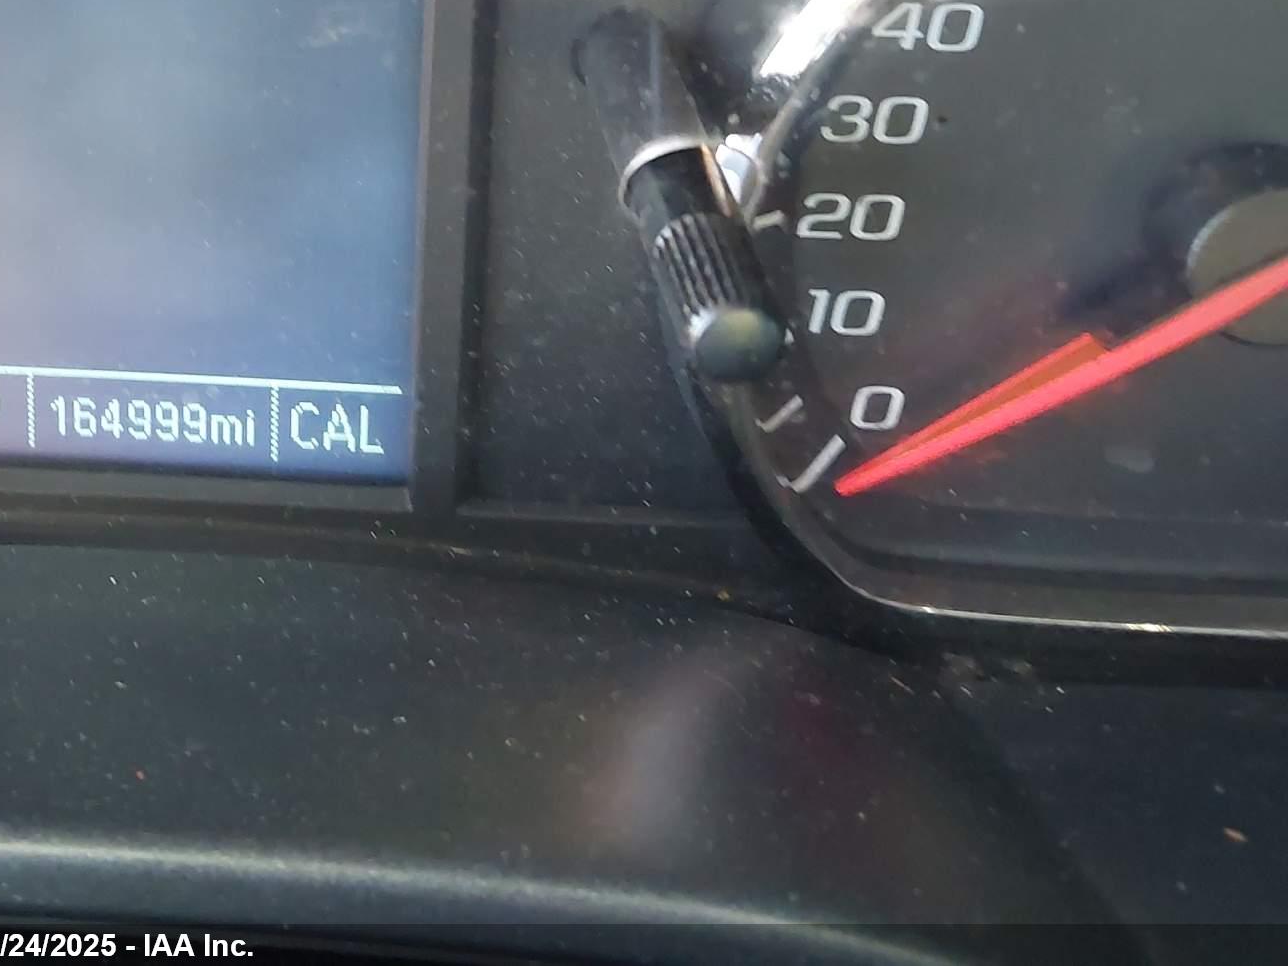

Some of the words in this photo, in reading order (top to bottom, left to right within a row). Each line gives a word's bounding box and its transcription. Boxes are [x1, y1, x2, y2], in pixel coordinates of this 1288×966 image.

[872, 2, 984, 52] 40
[820, 95, 929, 145] 30
[797, 192, 906, 241] 20
[808, 289, 885, 337] 10
[51, 396, 256, 447] 164999mi
[290, 402, 384, 455] CAL
[849, 385, 905, 431] 0
